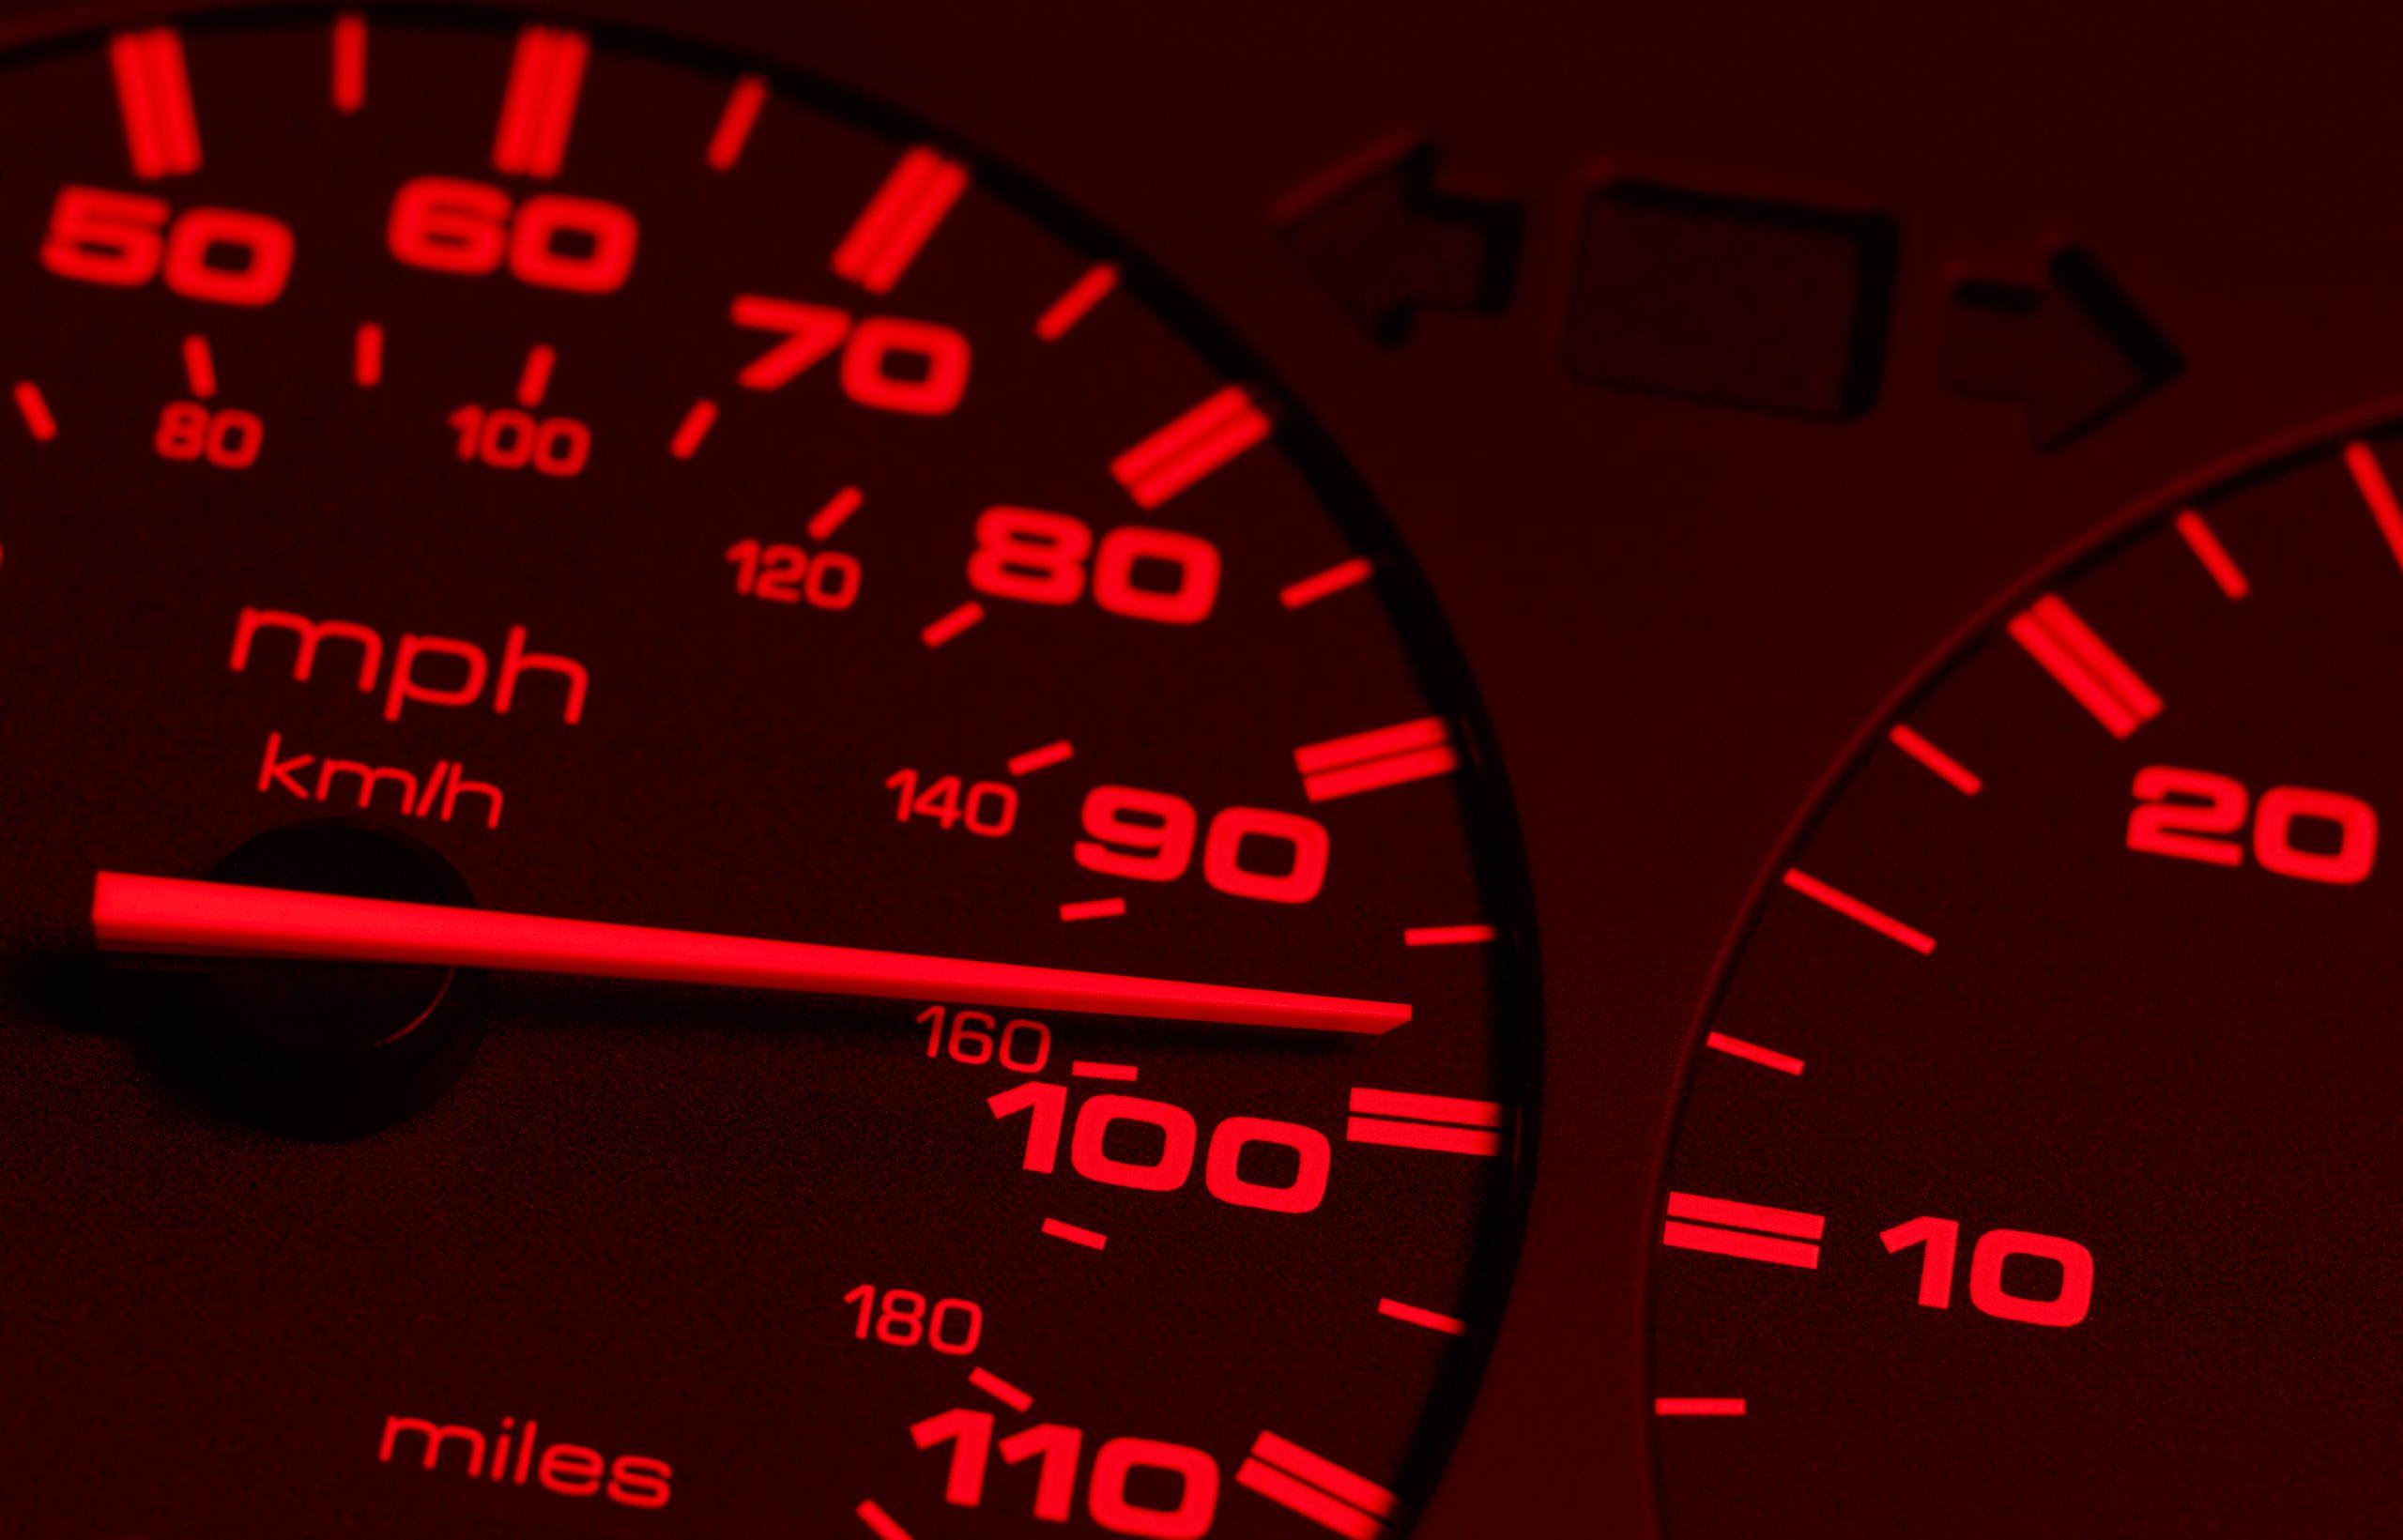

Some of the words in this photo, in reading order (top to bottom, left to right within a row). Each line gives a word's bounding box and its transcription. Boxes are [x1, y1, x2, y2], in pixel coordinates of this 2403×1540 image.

[40, 184, 296, 308] 50
[386, 175, 639, 295] 60
[729, 294, 972, 417] 70
[154, 401, 265, 469] 80
[447, 404, 591, 477] 100
[725, 539, 863, 611] 120
[967, 504, 1223, 626] 80
[229, 605, 590, 725] mph
[256, 731, 505, 830] km/h
[884, 767, 1019, 839] 140
[2125, 764, 2380, 886] 20
[1072, 784, 1332, 906] 90
[914, 1004, 1052, 1075] 160
[985, 1079, 1332, 1215] 100
[842, 1283, 984, 1357] 180
[1878, 1214, 2095, 1329] 10
[378, 1414, 674, 1509] miles
[909, 1407, 1221, 1540] 110
